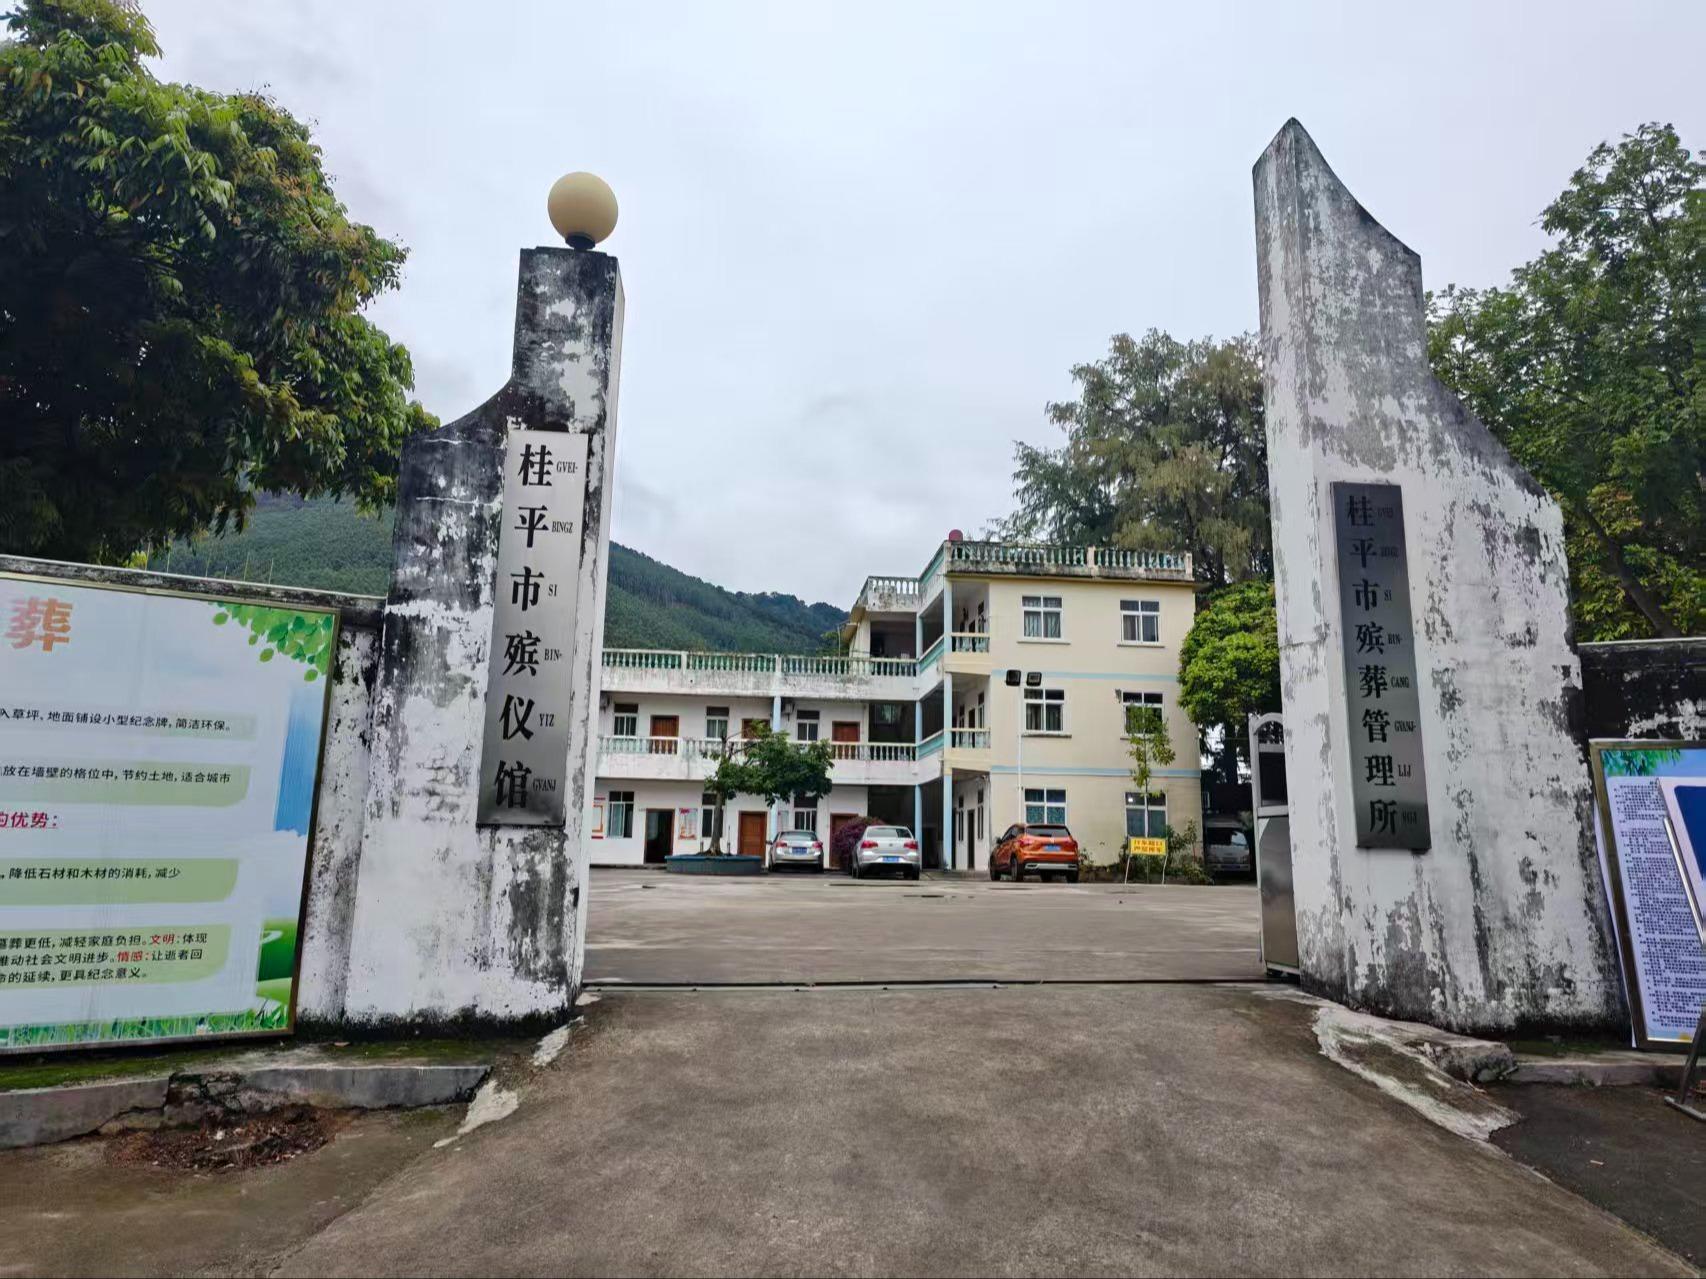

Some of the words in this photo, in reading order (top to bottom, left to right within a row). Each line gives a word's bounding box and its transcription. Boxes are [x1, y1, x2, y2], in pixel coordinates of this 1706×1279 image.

[552, 520, 573, 534] BINGZ
[548, 584, 557, 597] SI
[5, 596, 73, 652] 葬
[495, 444, 553, 808] 桂平市殡仪馆
[1347, 495, 1398, 835] 桂平市殡葬管理所
[539, 714, 555, 727] YIZ
